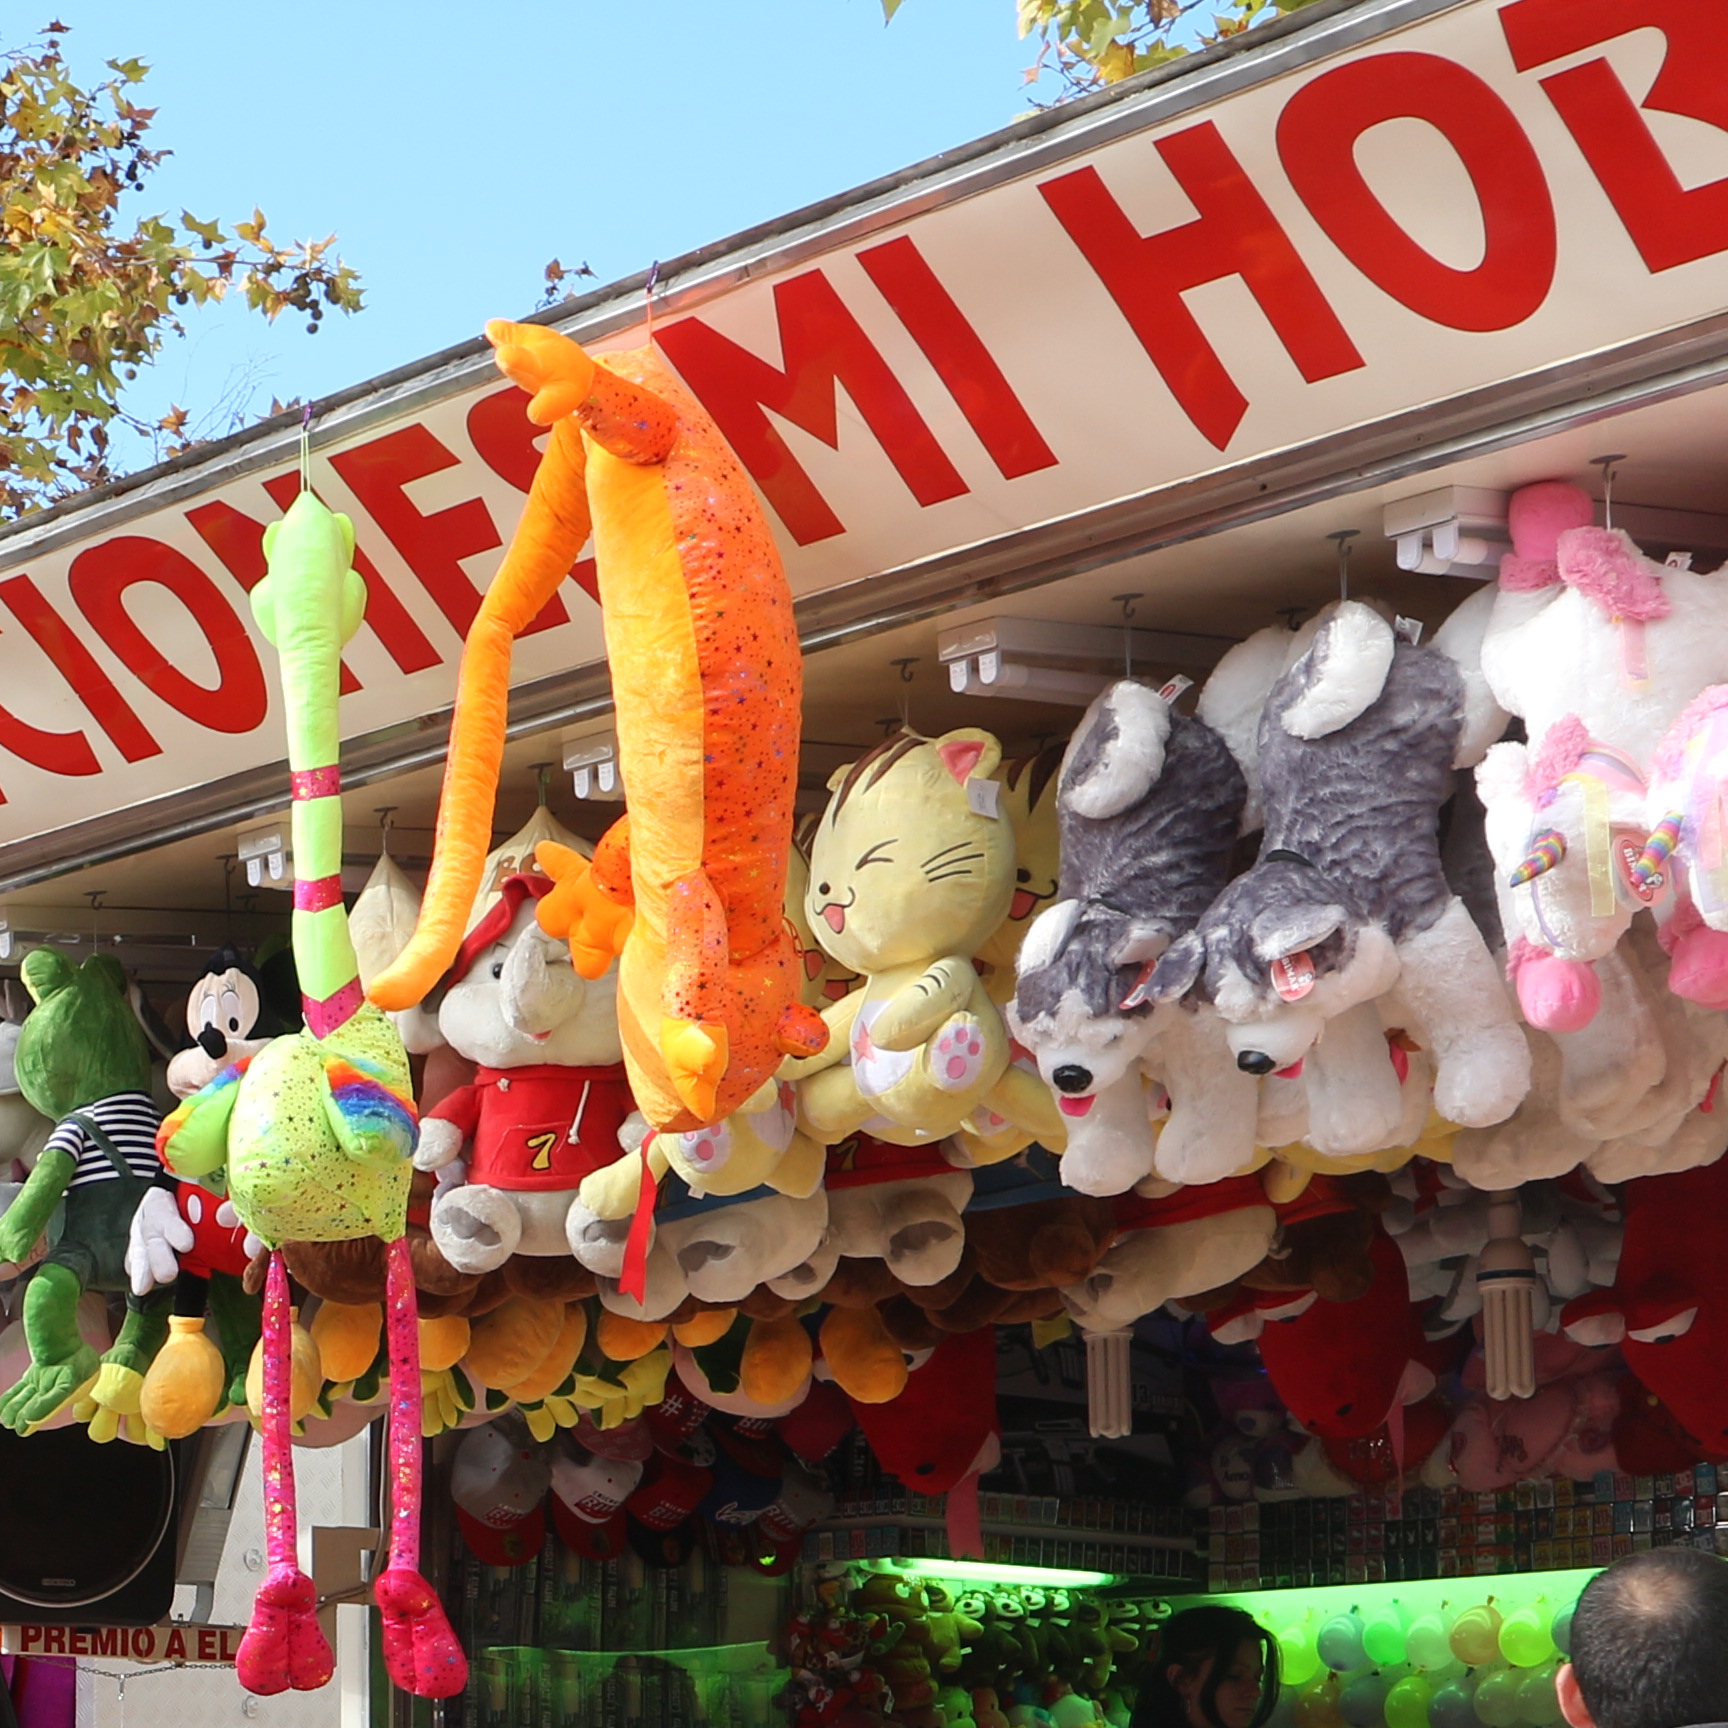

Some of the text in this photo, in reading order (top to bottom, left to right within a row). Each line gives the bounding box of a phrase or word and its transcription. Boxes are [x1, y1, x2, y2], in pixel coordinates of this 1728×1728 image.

[651, 235, 1060, 548] MI
[526, 1131, 557, 1170] 7
[19, 1625, 155, 1658] PREMIO
[164, 1628, 187, 1660] A
